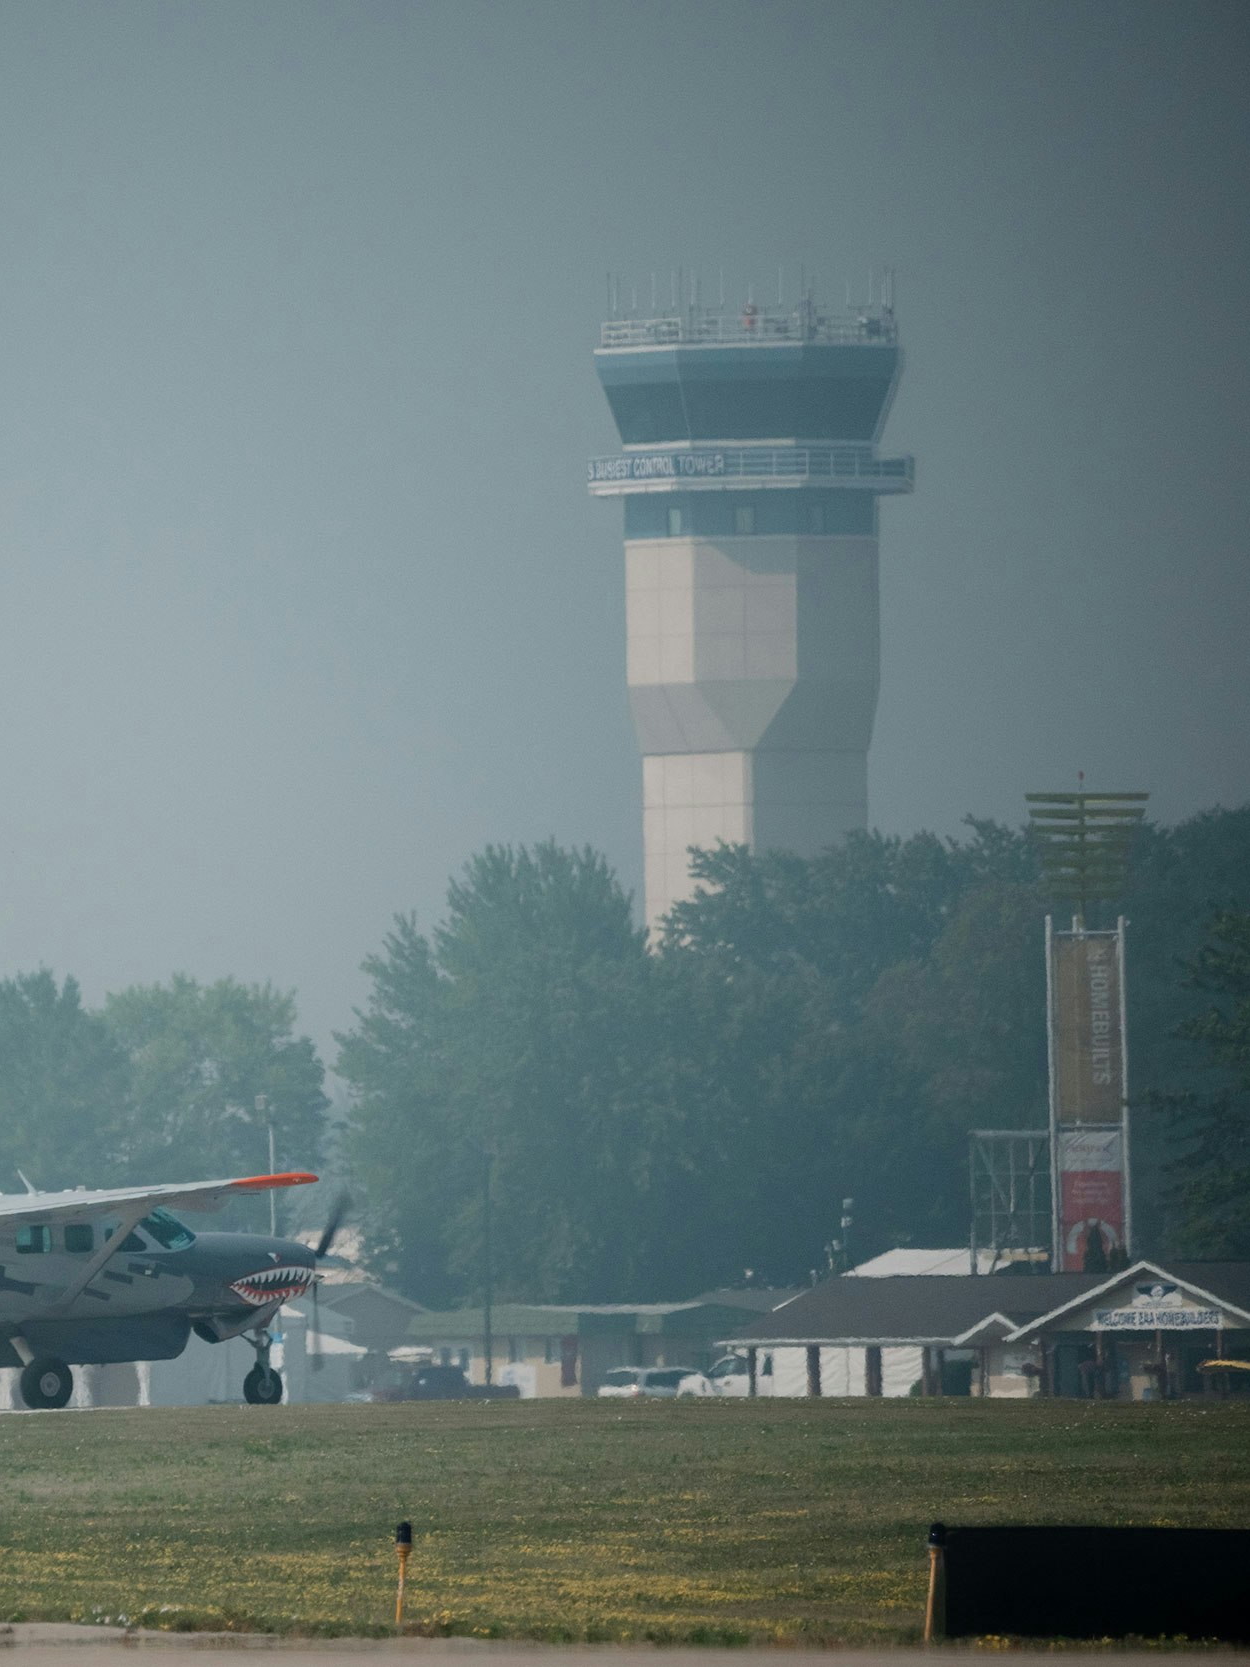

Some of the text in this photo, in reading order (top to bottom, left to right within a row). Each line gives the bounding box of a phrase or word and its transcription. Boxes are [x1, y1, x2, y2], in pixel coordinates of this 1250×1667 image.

[633, 456, 675, 477] CONTROL
[678, 454, 725, 475] TOWER
[1090, 965, 1112, 1086] HOMEBUILTS
[1097, 1312, 1137, 1326] WELCOME
[1156, 1311, 1220, 1325] HOMEBUILDERS
